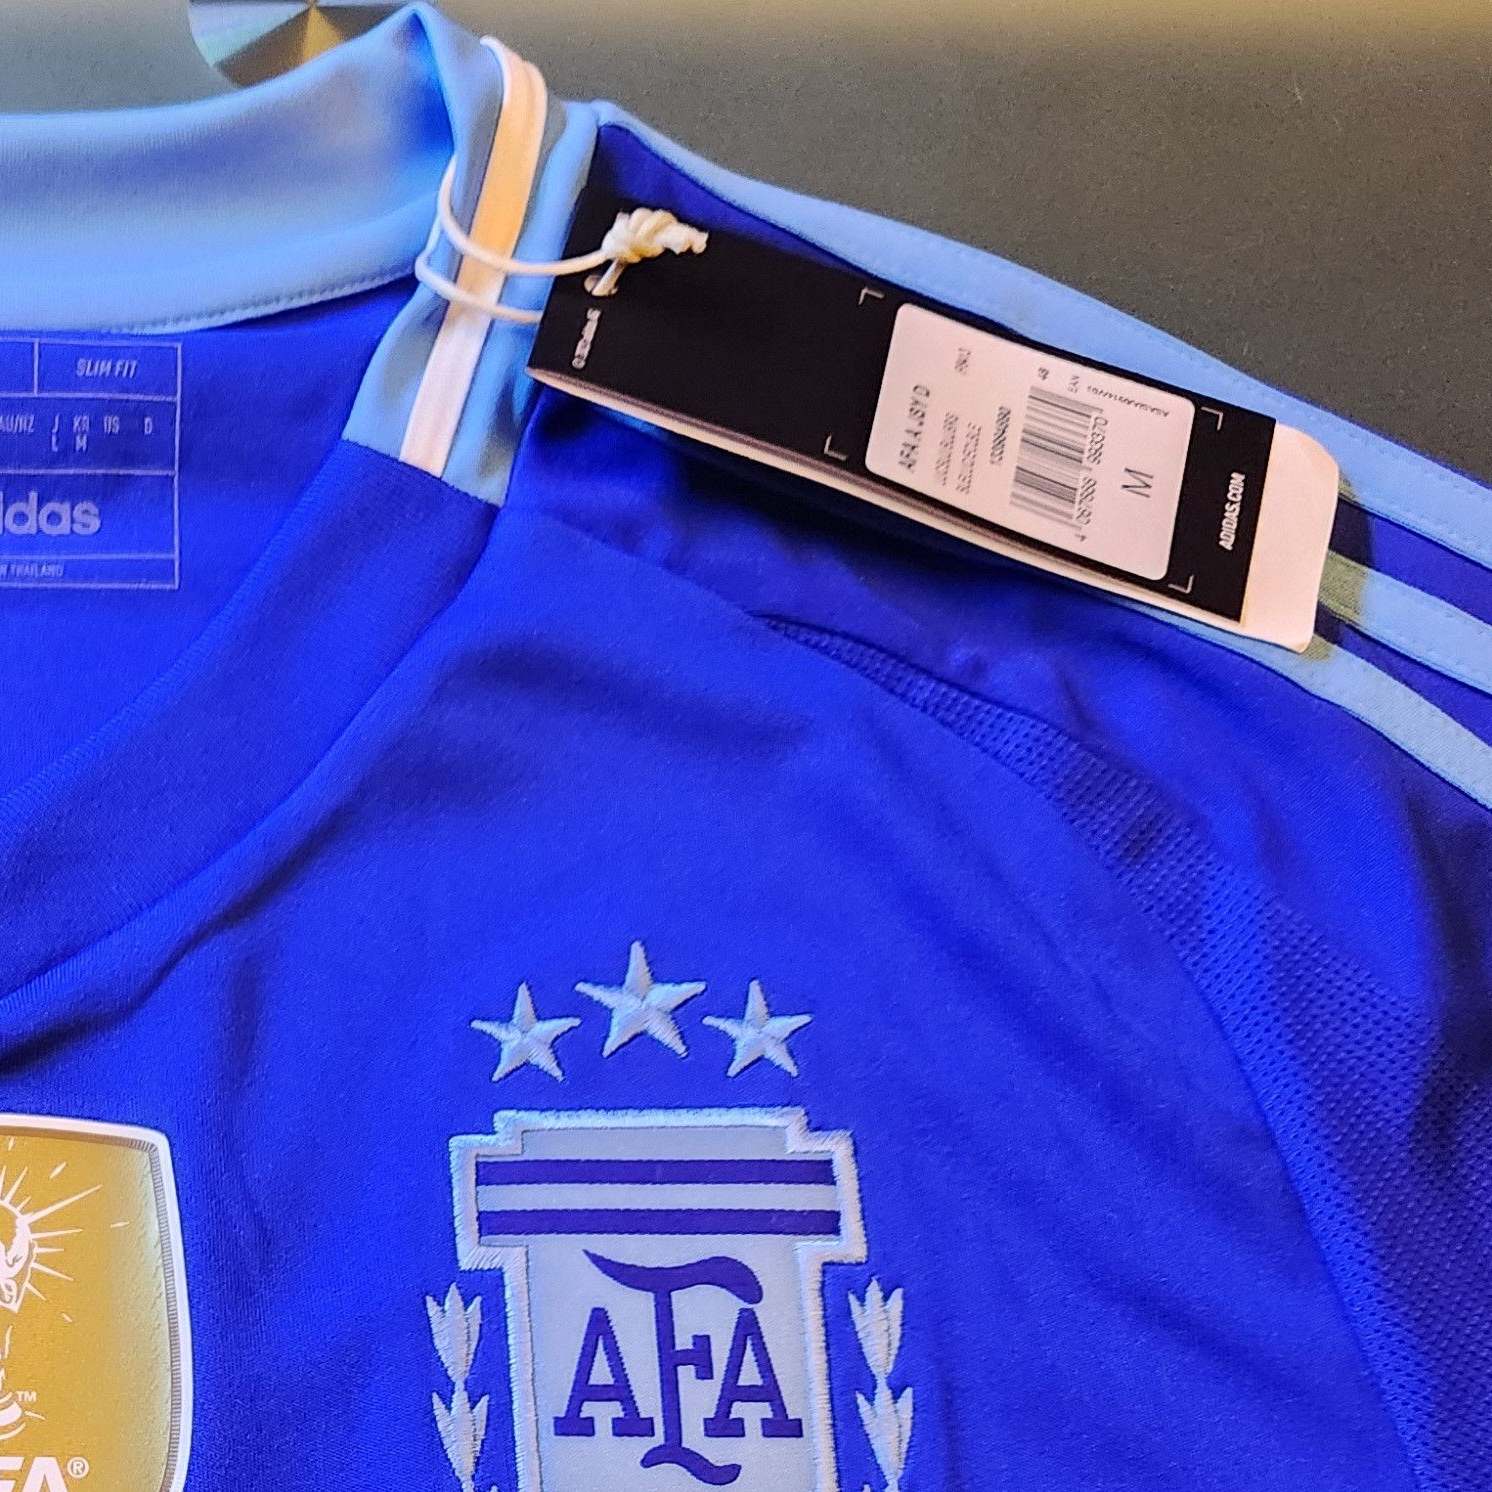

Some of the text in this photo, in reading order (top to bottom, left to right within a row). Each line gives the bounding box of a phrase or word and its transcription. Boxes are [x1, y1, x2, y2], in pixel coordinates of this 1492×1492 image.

[76, 357, 139, 379] SLIM FIT
[1121, 467, 1154, 498] M
[1219, 472, 1246, 551] ADIDAS.COM
[553, 1249, 803, 1486] AFA
